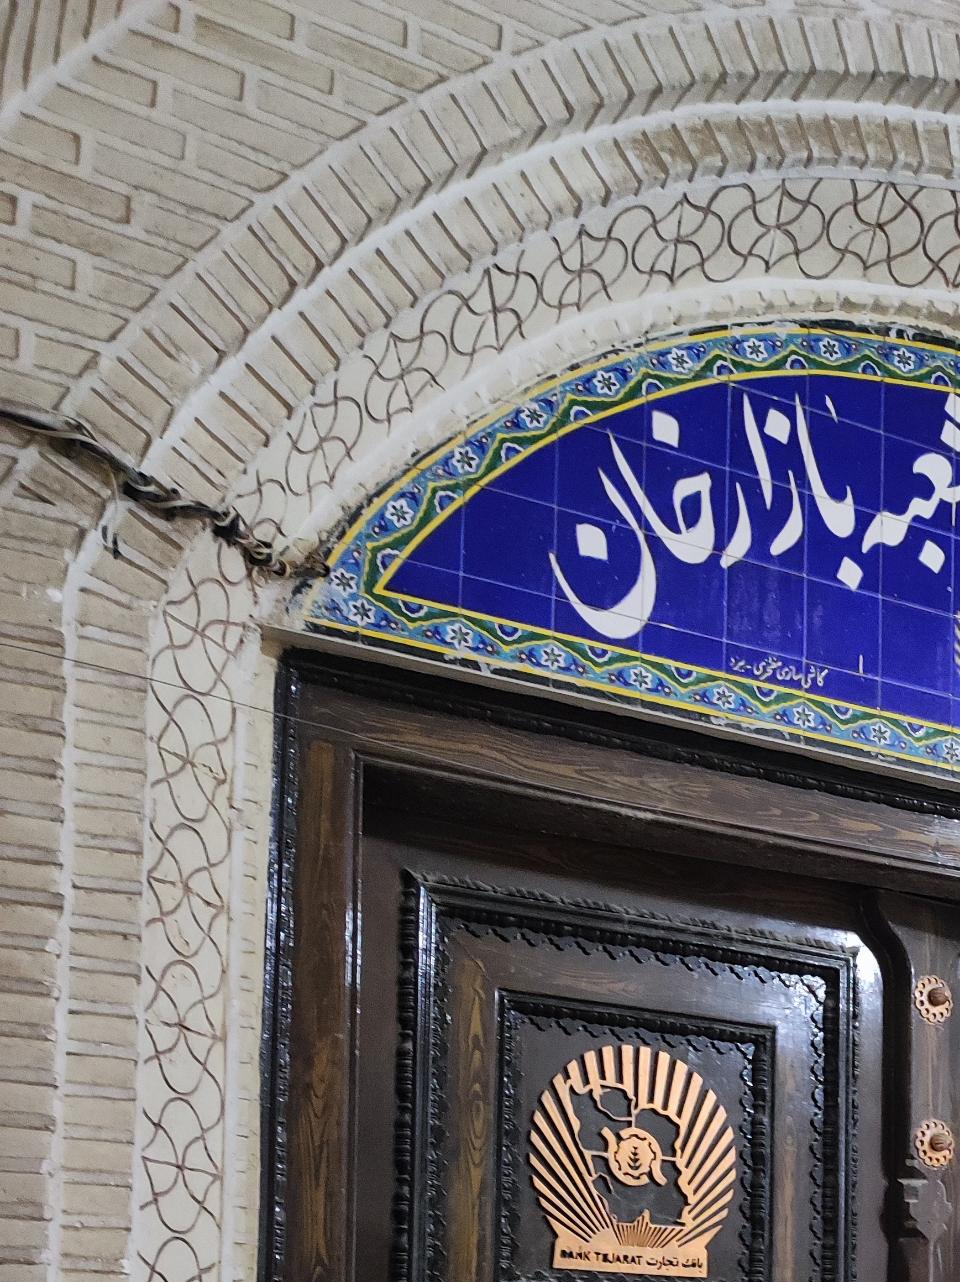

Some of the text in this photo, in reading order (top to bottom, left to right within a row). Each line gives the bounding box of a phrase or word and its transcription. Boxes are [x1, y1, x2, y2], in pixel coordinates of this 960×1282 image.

[560, 1249, 644, 1266] BANK TEJARAT
[645, 1255, 679, 1271] تجارت
